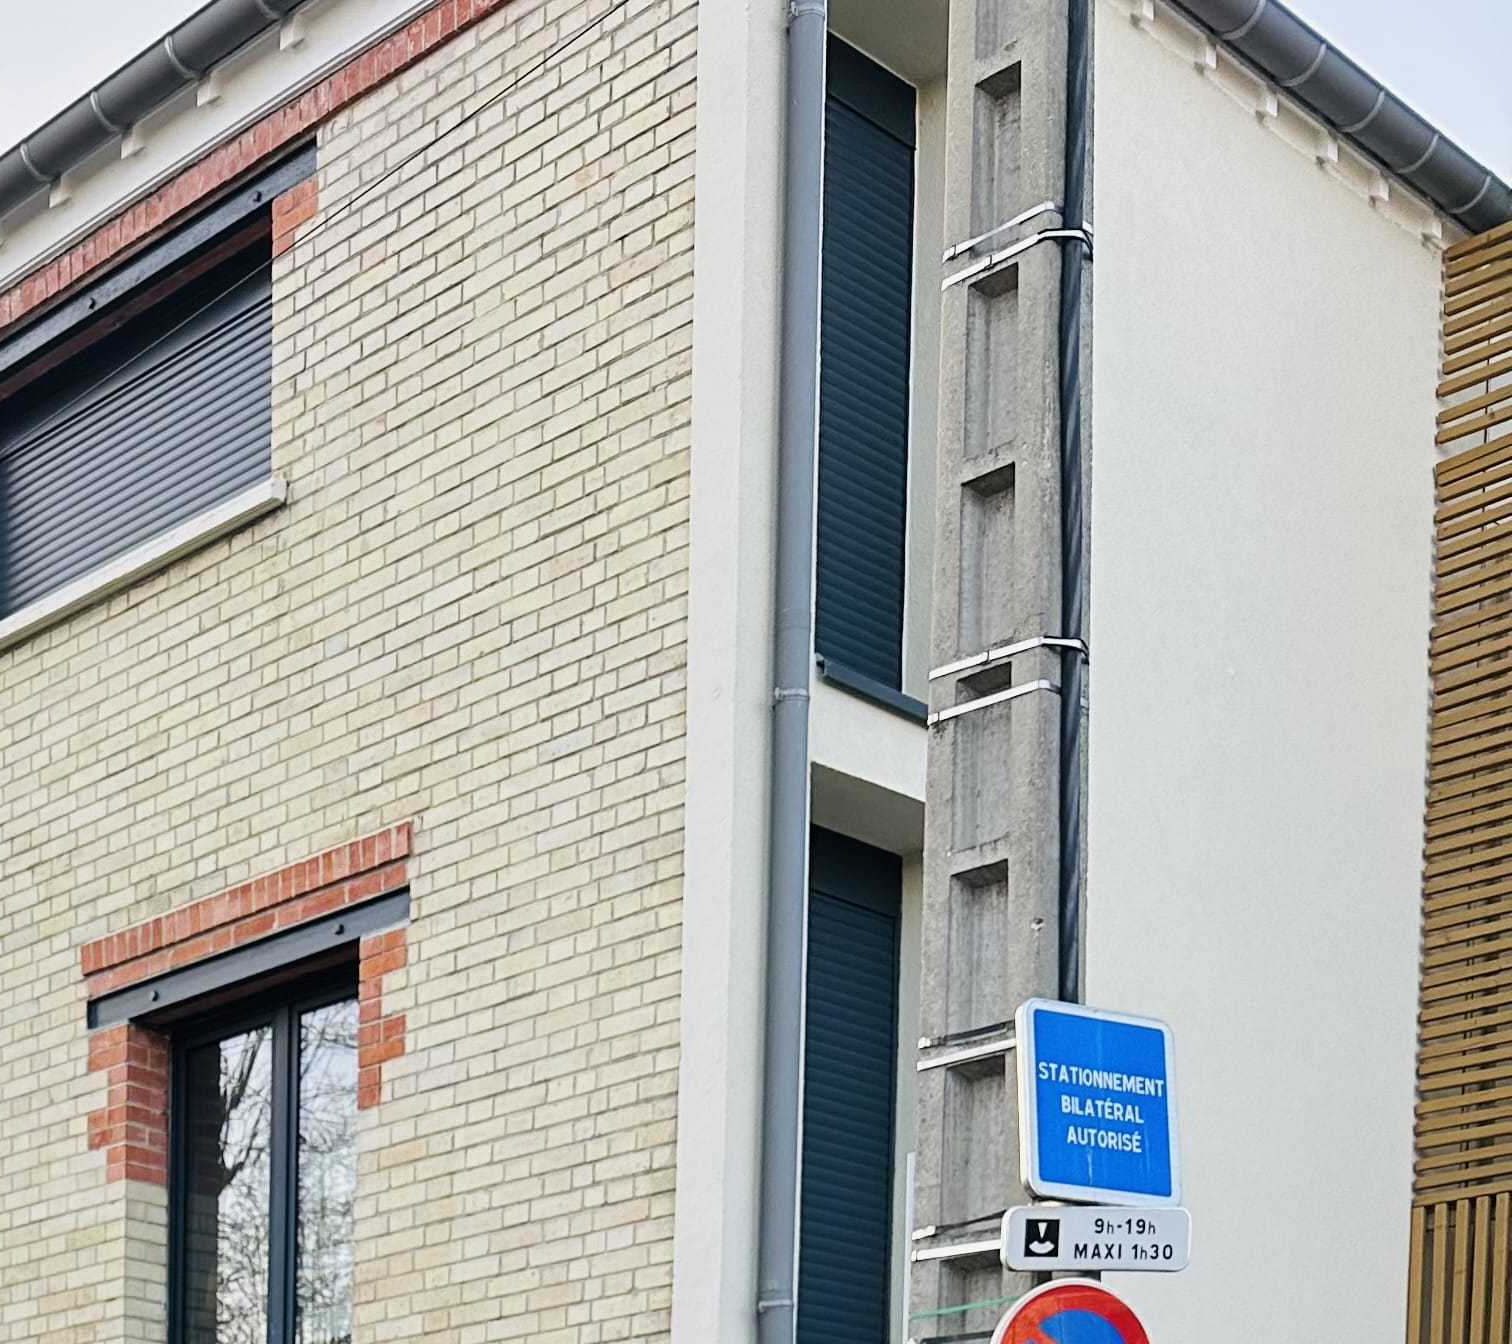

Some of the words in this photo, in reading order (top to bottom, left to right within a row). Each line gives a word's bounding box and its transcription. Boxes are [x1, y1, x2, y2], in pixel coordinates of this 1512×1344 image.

[1038, 1061, 1165, 1097] STATIONNEMENT
[1061, 1094, 1144, 1124] BILATÉRAL
[1067, 1125, 1142, 1153] AUTORISÉ
[1094, 1217, 1156, 1235] 9h-19h
[1074, 1243, 1122, 1260] MAXI
[1131, 1243, 1173, 1260] 1h30
